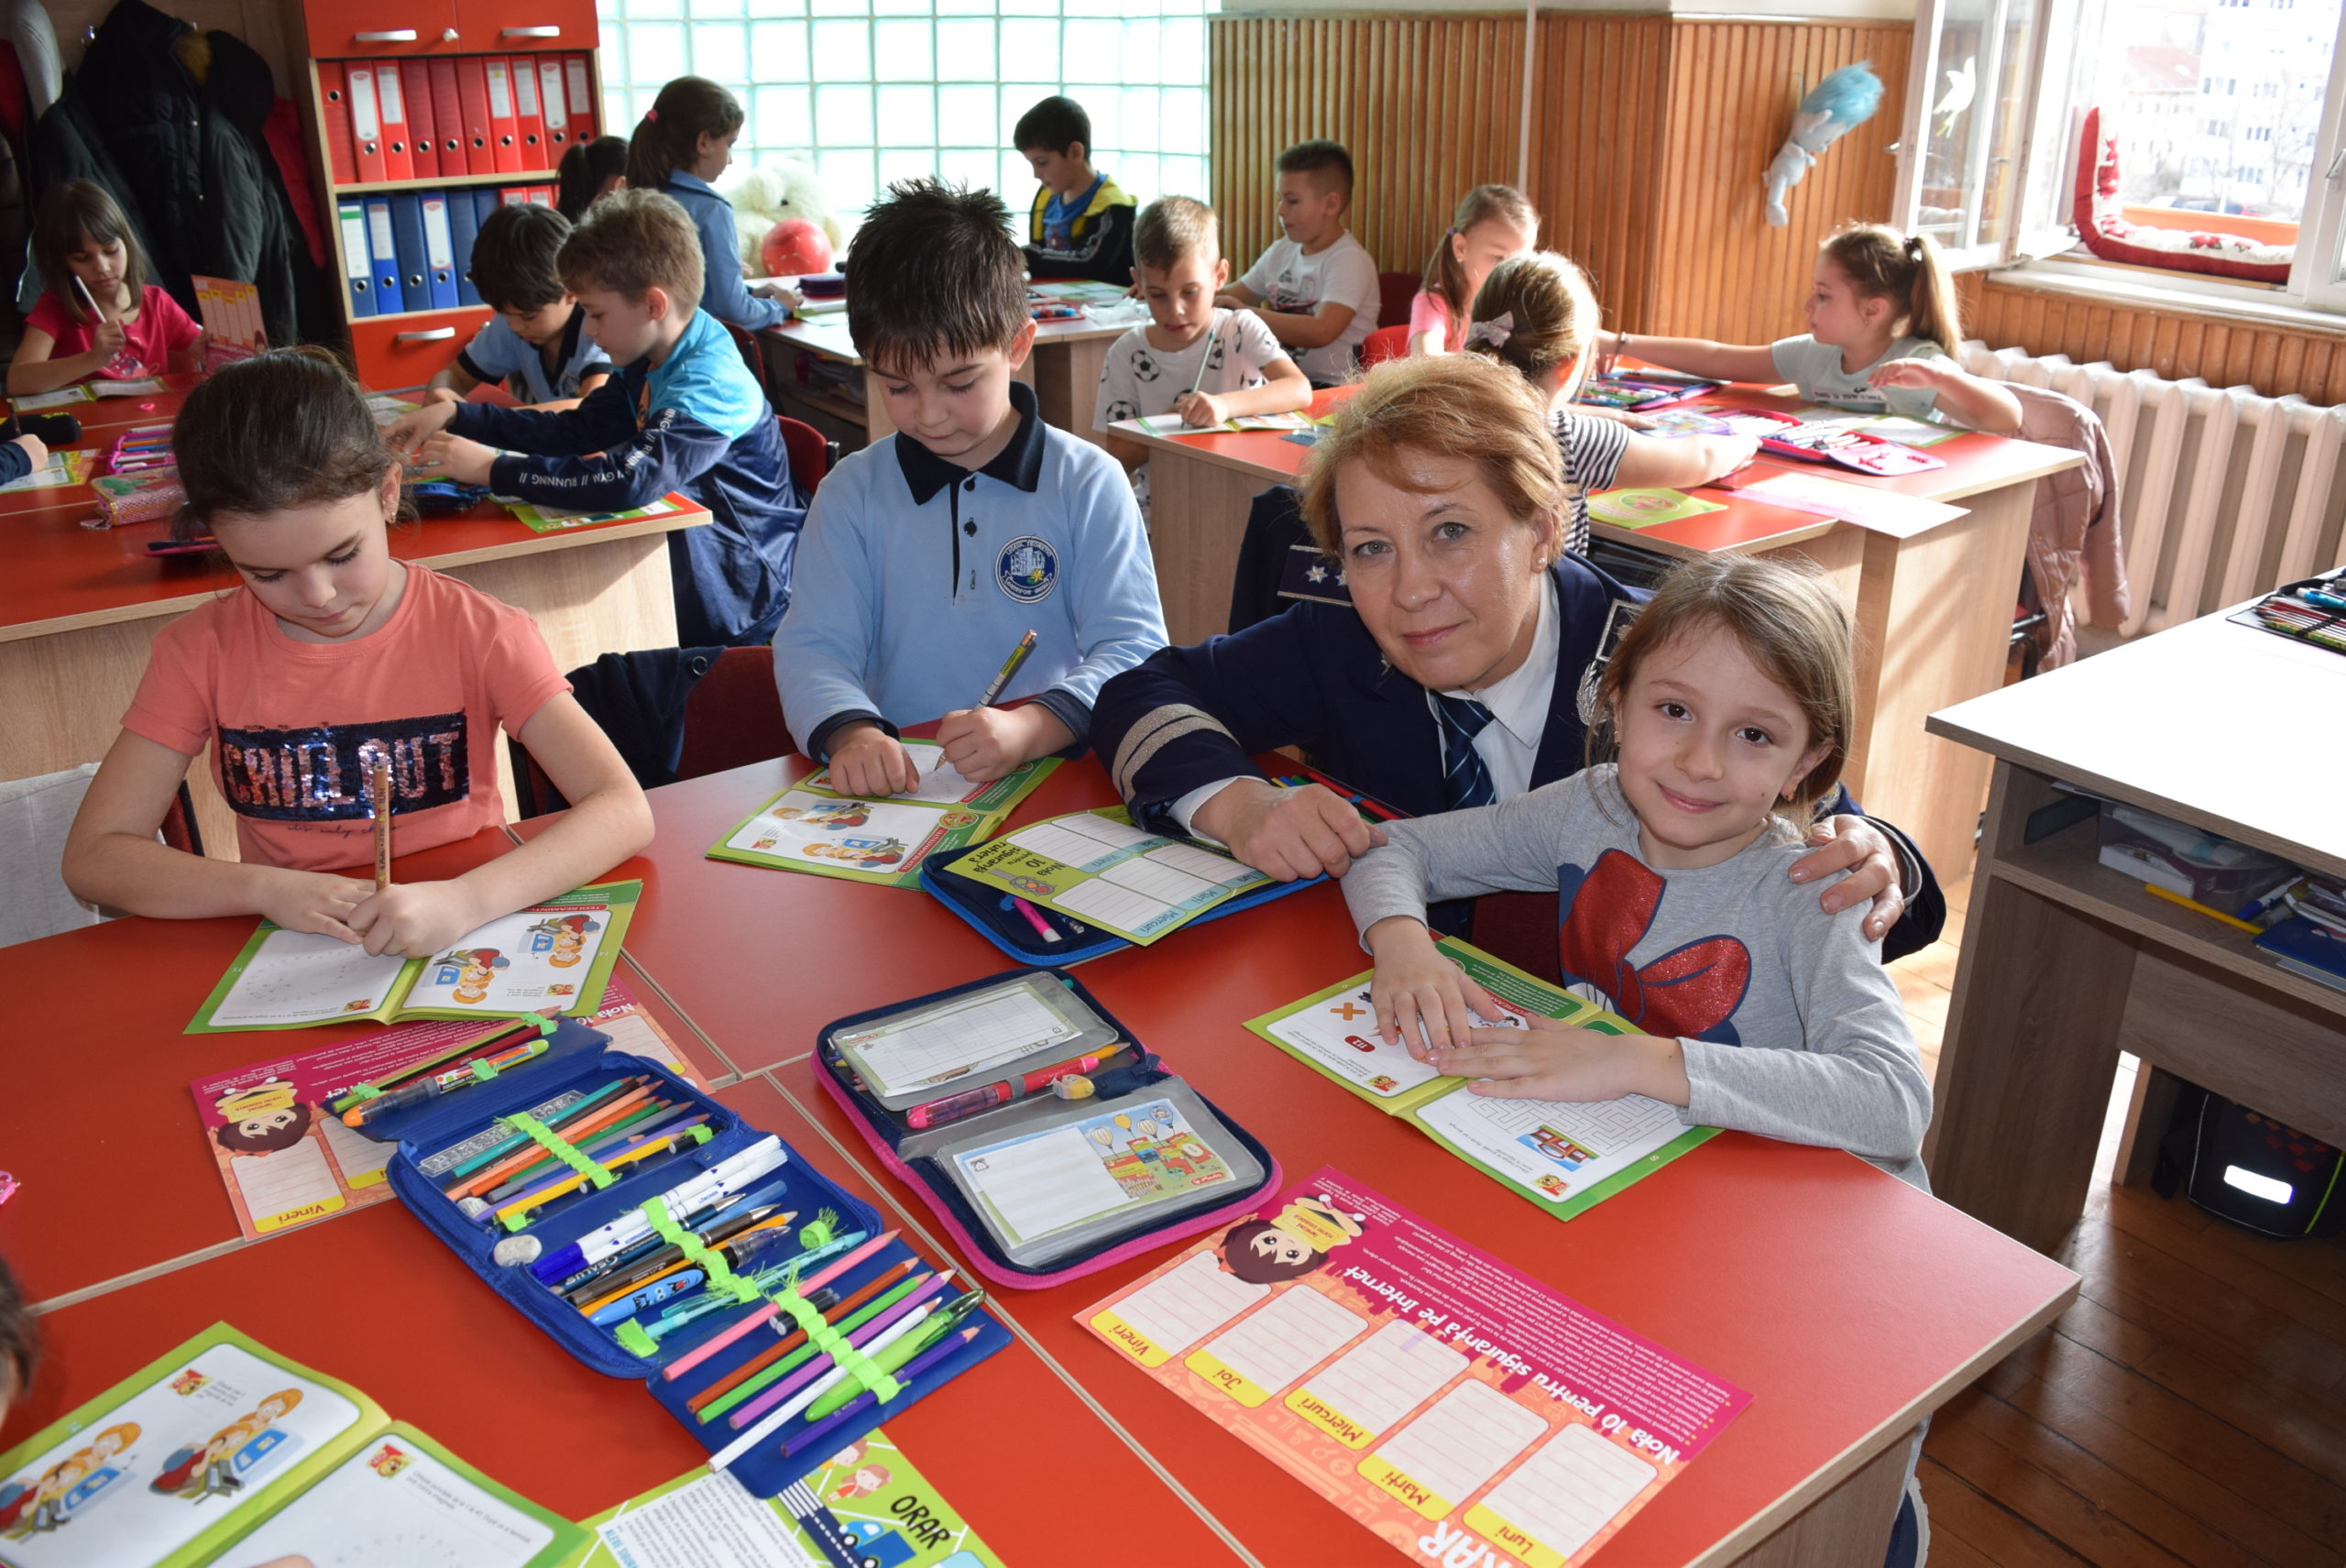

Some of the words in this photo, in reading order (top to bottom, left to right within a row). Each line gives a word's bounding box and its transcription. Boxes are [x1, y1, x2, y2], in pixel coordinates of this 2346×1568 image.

[1025, 857, 1047, 870] 10
[1139, 909, 1178, 934] Miercuri
[597, 1002, 635, 1020] Nota
[1351, 1036, 1369, 1051] 112
[278, 1203, 326, 1224] Vineri
[1343, 1266, 1419, 1312] Internet
[1426, 1309, 1448, 1326] pe
[1115, 1322, 1149, 1358] Vineri
[1440, 1318, 1532, 1376] siguranță
[1215, 1367, 1244, 1391] Joi
[1532, 1373, 1605, 1418] pentru
[1298, 1397, 1365, 1443] Miercuri
[1601, 1414, 1628, 1434] 10
[1630, 1429, 1680, 1467] Nota
[1381, 1470, 1431, 1506] Marți
[890, 1495, 952, 1551] ORAR
[1494, 1525, 1535, 1556] Luni
